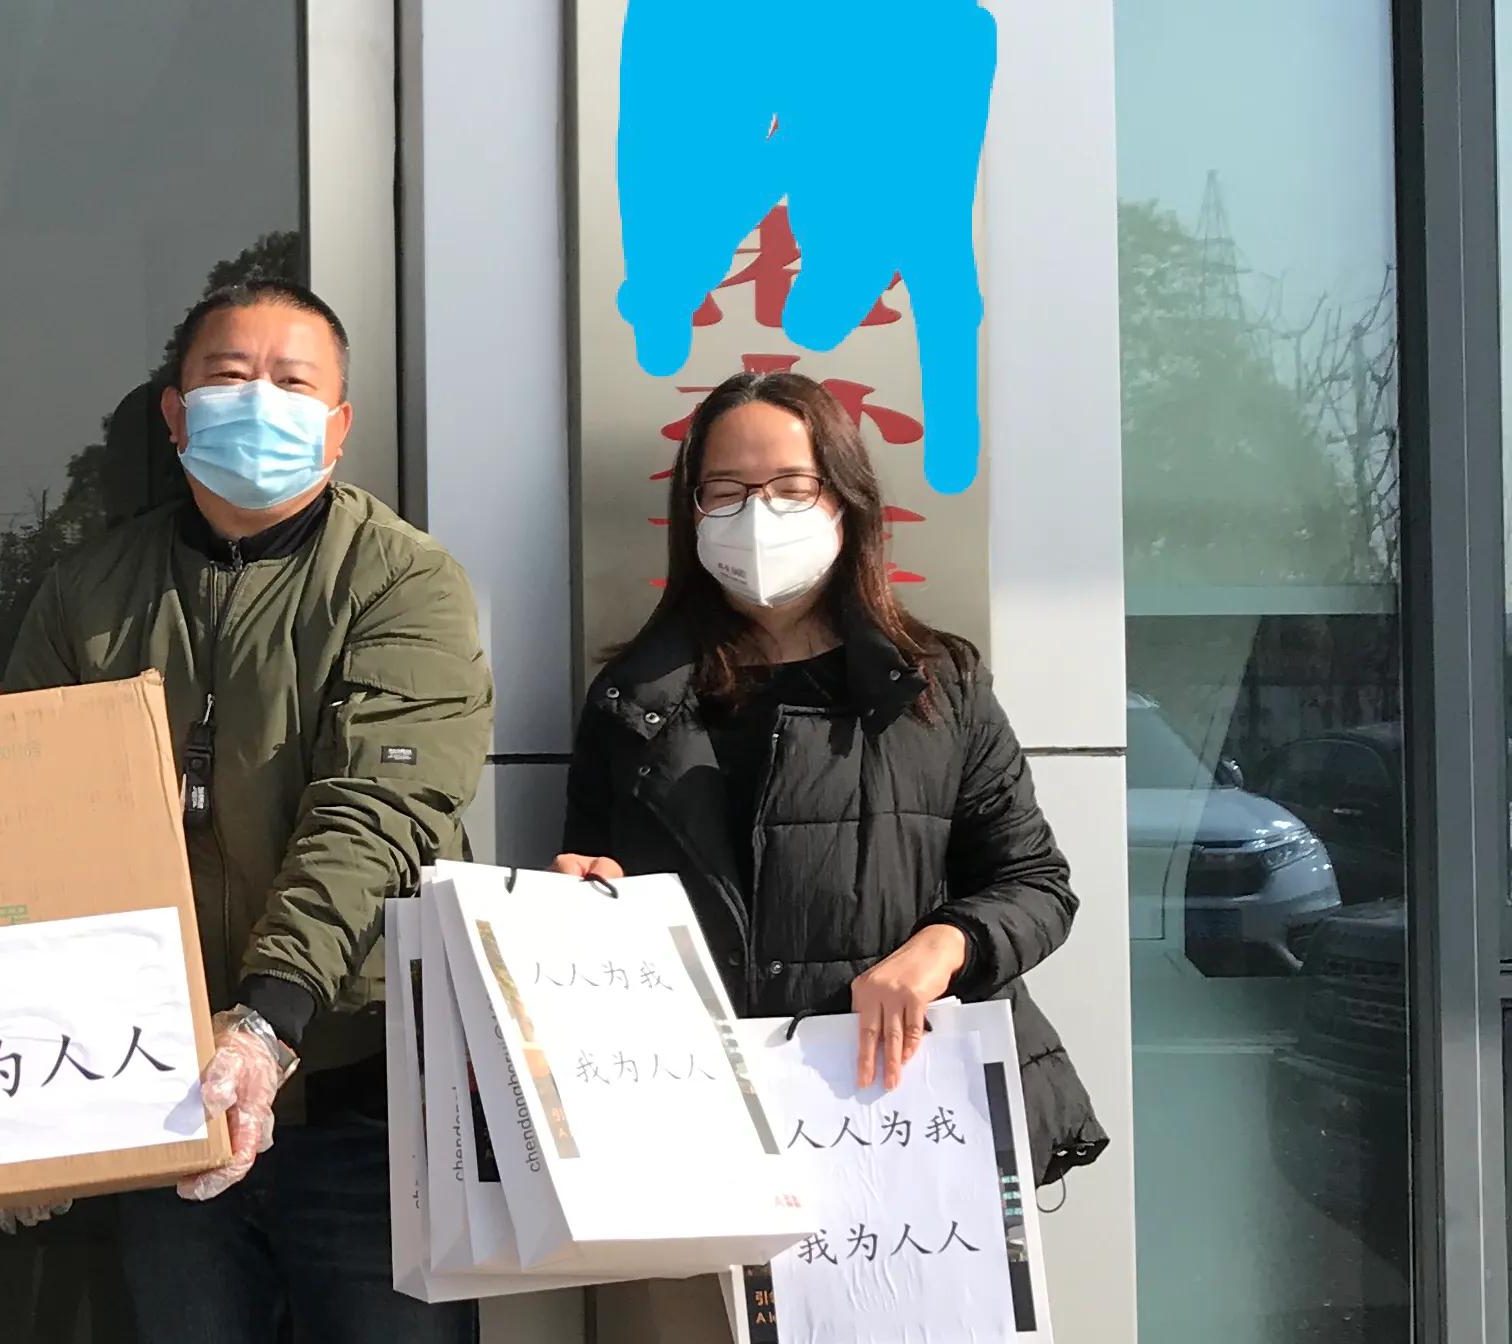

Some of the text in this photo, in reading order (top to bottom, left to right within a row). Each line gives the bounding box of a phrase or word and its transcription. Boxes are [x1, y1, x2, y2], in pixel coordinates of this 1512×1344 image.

[534, 960, 674, 991] 人人为我
[576, 1049, 717, 1085] 我为人人
[787, 1106, 966, 1148] 人人为我
[797, 1220, 981, 1265] 我为人人
